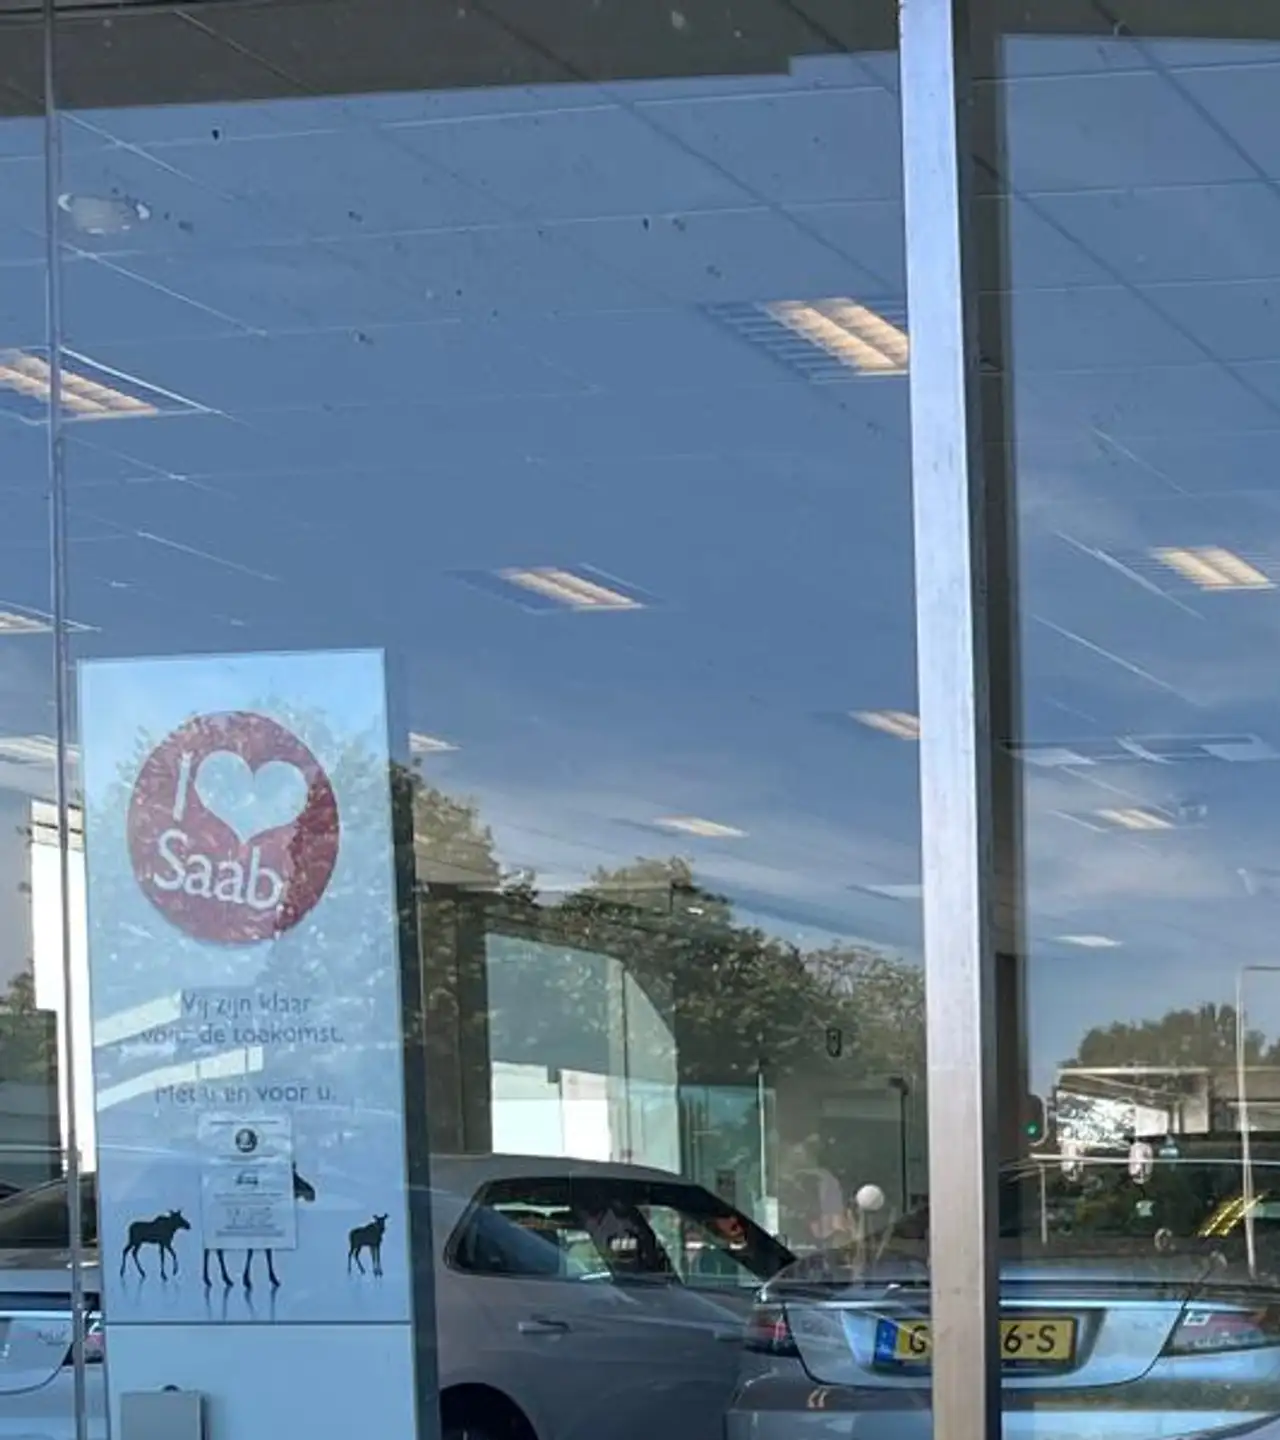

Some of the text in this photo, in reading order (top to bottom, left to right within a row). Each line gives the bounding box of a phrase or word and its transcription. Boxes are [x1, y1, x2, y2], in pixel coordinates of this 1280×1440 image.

[172, 751, 193, 822] I
[257, 989, 312, 1014] klaar
[198, 1023, 226, 1044] de
[255, 1084, 310, 1103] voor
